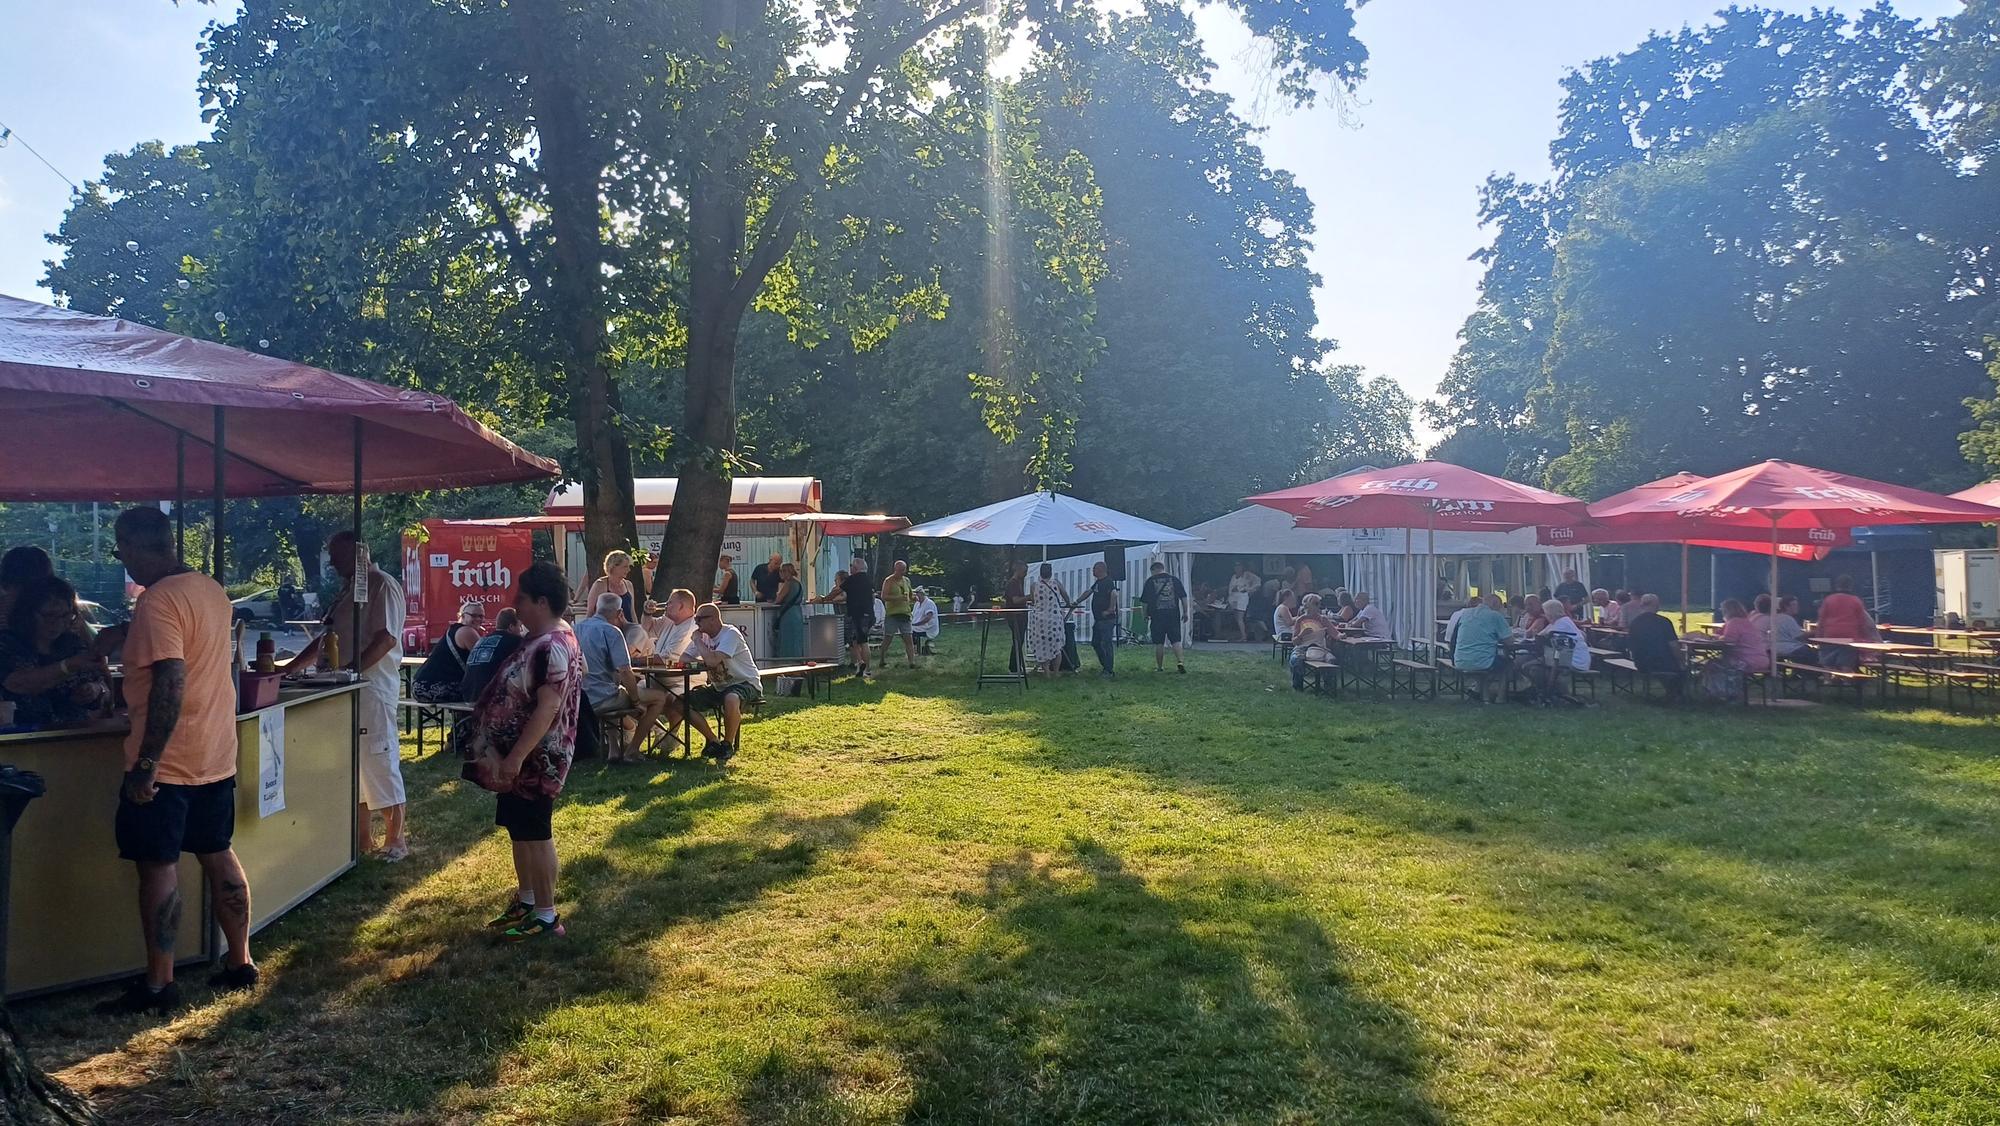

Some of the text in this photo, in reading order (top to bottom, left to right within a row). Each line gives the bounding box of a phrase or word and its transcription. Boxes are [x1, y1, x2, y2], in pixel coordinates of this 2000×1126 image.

[1551, 527, 1574, 539] früh
[1807, 528, 1836, 541] früh
[459, 593, 501, 604] KÖLSCH
